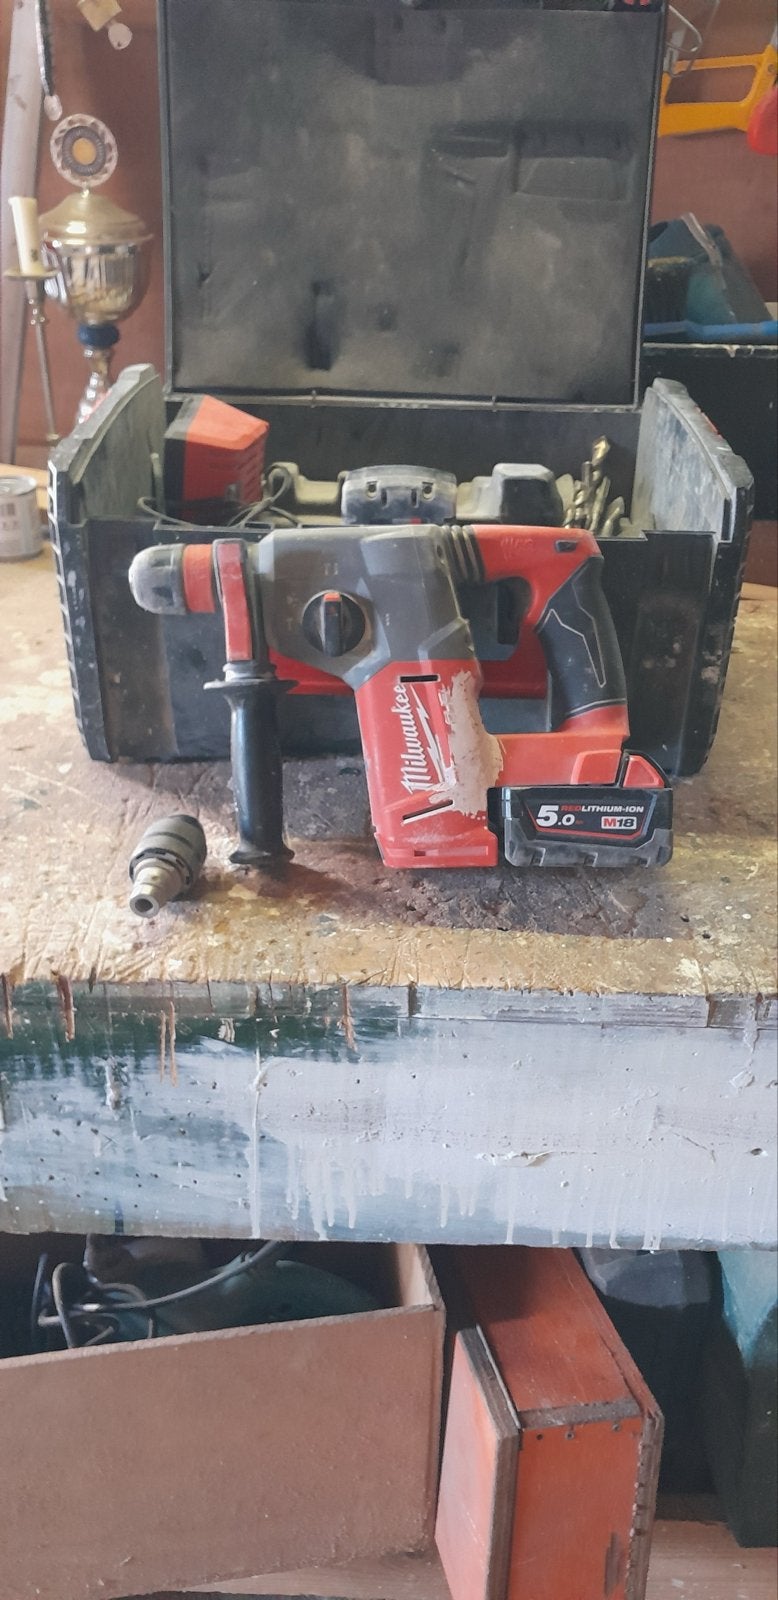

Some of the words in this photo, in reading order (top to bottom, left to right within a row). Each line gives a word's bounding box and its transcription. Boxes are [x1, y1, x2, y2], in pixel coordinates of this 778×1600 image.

[391, 683, 434, 794] Milwaukee
[536, 804, 575, 828] 5.0
[602, 817, 635, 828] M18
